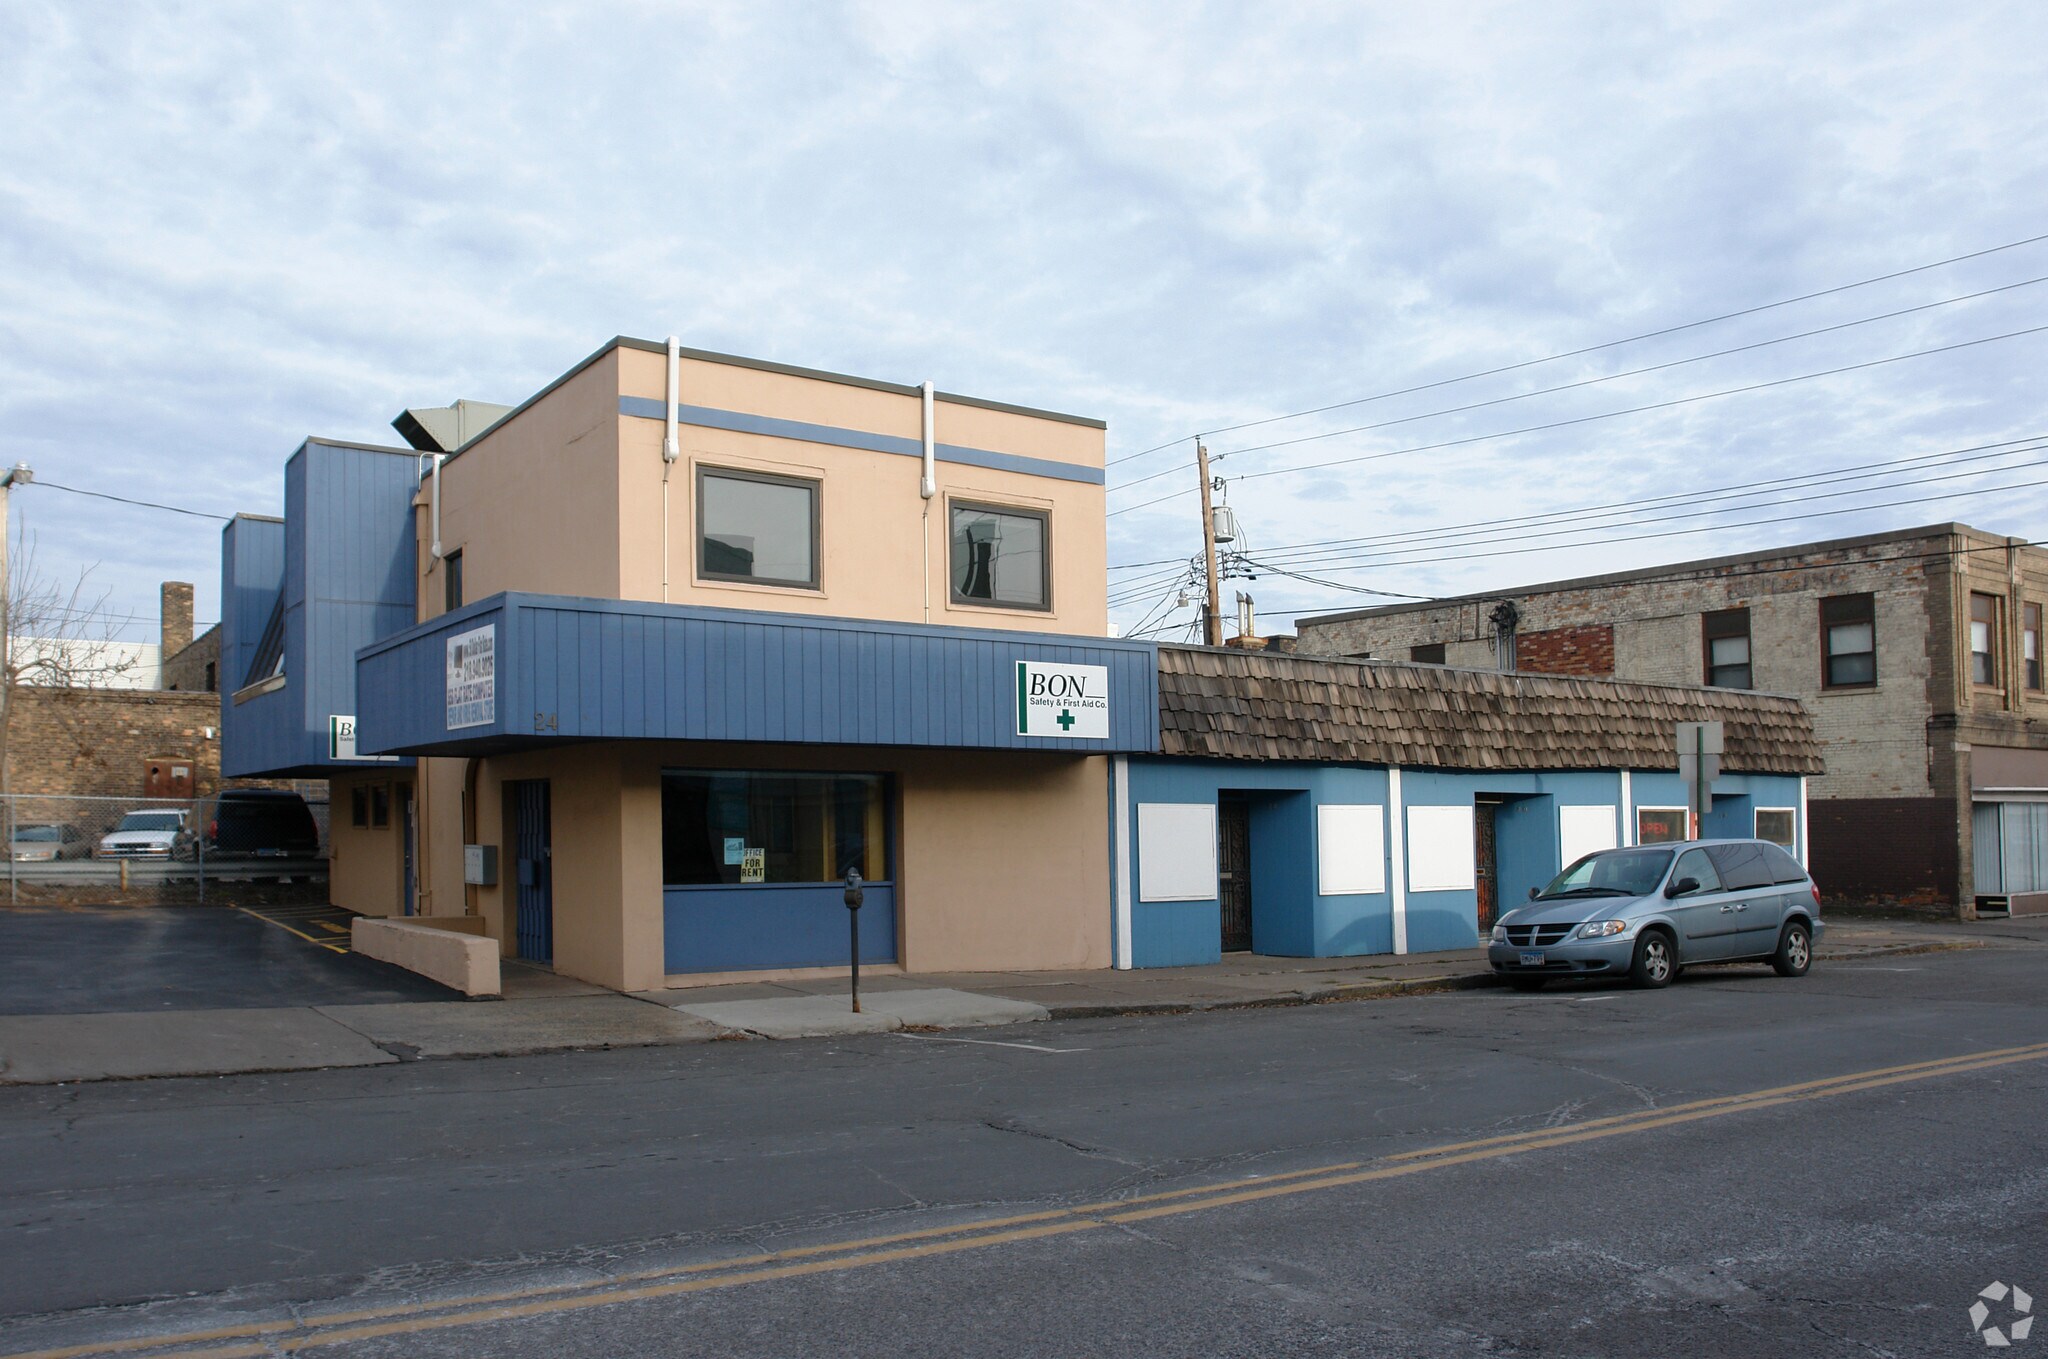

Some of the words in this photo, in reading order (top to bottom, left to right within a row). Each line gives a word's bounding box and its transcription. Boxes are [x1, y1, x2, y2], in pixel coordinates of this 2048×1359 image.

[1029, 672, 1087, 698] BON
[1030, 697, 1054, 707] Safety
[1063, 699, 1080, 708] First
[1082, 700, 1094, 708] Aid
[1095, 700, 1108, 709] Co.
[535, 712, 557, 731] 24
[340, 722, 356, 736] B
[1640, 822, 1668, 835] OPEN
[745, 859, 761, 867] FOR
[741, 868, 763, 877] RENT
